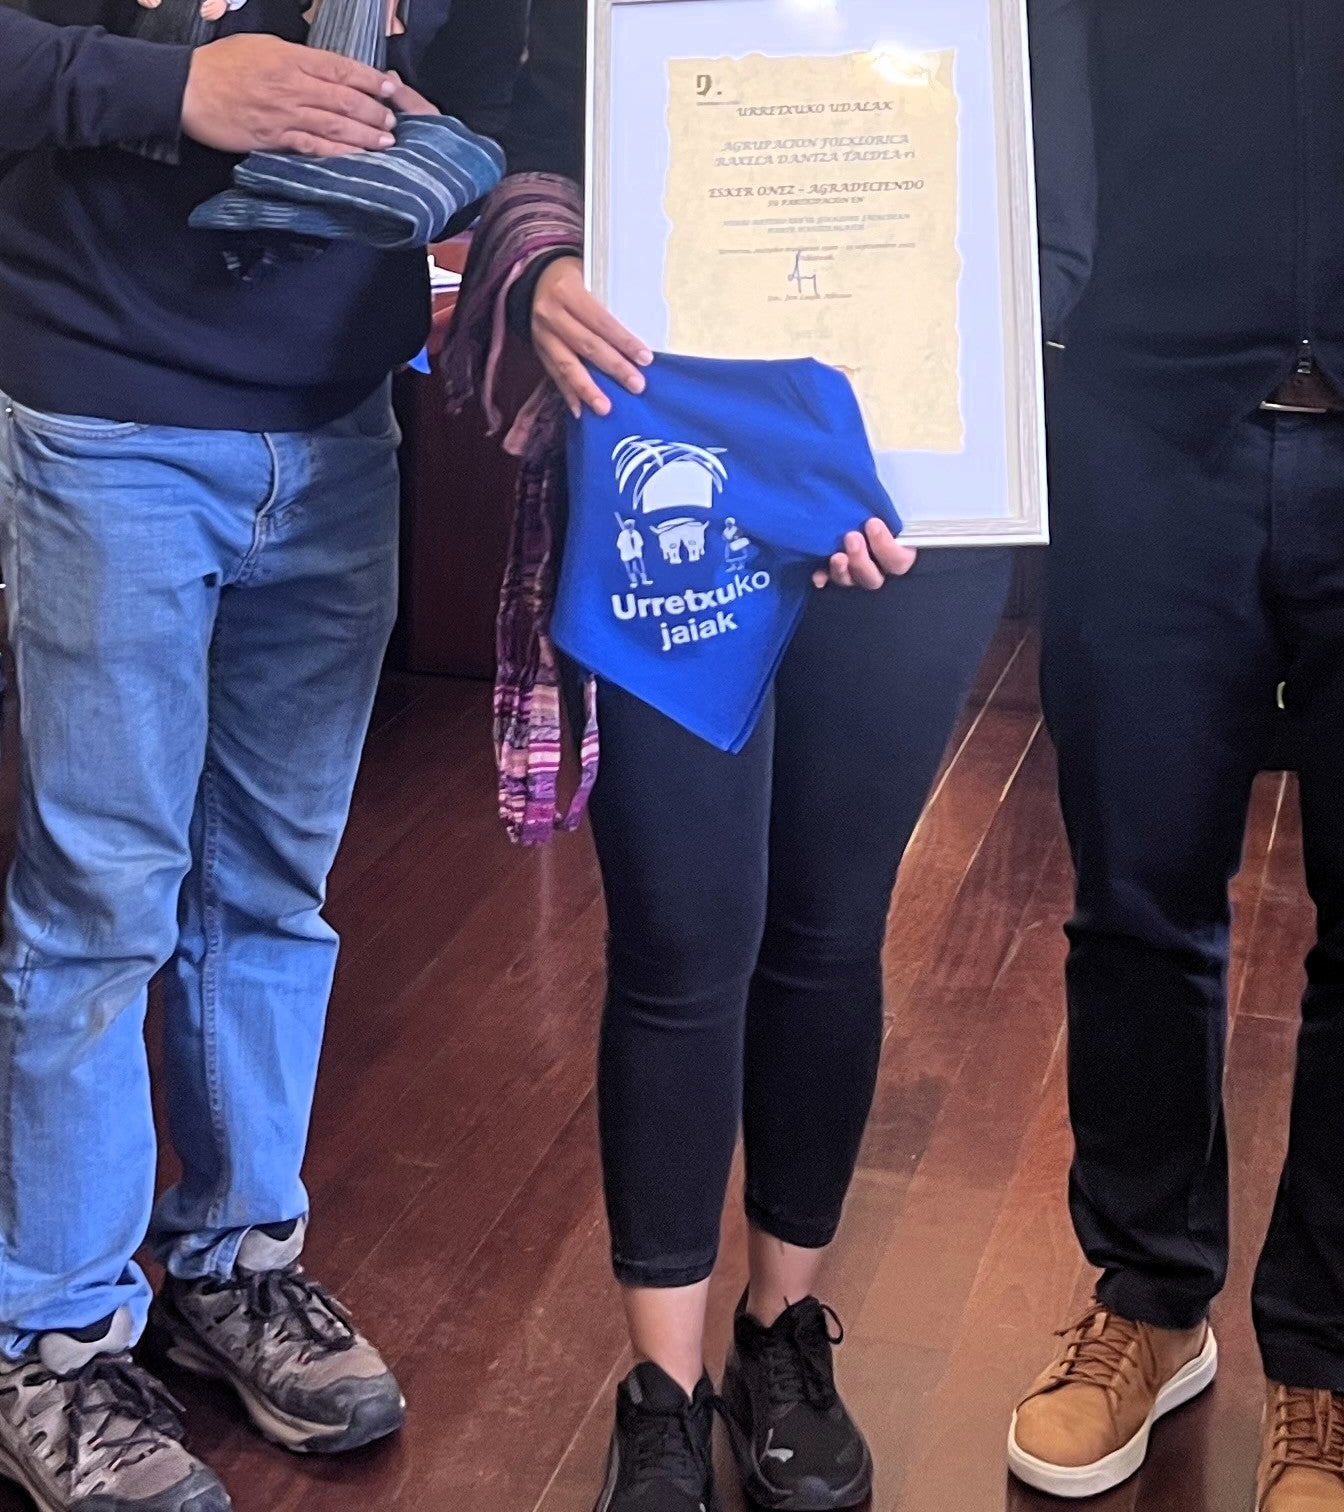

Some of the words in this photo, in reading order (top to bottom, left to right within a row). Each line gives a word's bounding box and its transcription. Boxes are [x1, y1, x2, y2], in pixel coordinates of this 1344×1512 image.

[757, 184, 795, 197] ONEZ
[807, 180, 925, 195] AGRADECIENDO
[611, 570, 771, 620] Urretxuko
[659, 610, 739, 652] jaiak
